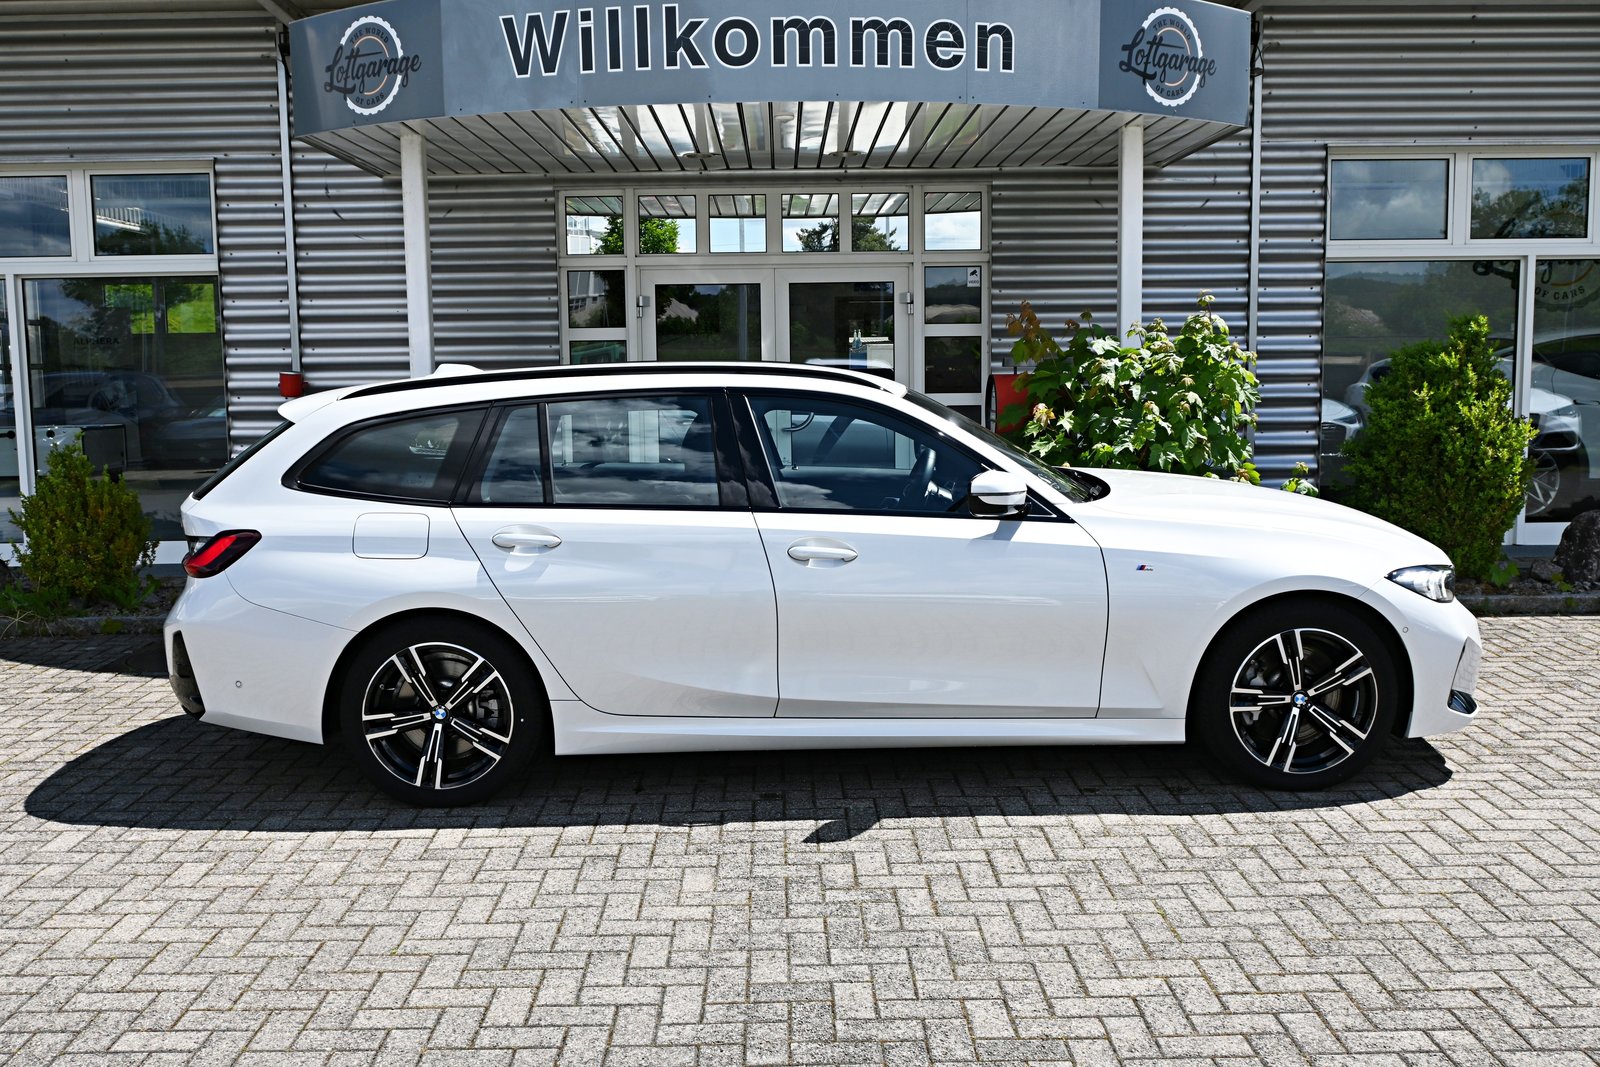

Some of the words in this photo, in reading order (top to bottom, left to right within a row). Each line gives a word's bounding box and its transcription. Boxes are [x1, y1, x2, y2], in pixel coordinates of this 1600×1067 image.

[350, 29, 363, 44] THE
[365, 27, 389, 44] WORLD
[1153, 19, 1167, 30] THE
[1170, 19, 1191, 40] WORLD
[499, 3, 1015, 79] Willkommen
[1119, 26, 1217, 88] Loftgarage
[324, 44, 422, 101] Loftgarage
[366, 92, 384, 105] CARS
[1155, 85, 1164, 94] OF
[1167, 87, 1184, 97] CARS
[1535, 287, 1550, 298] OF
[1553, 285, 1585, 301] CARS
